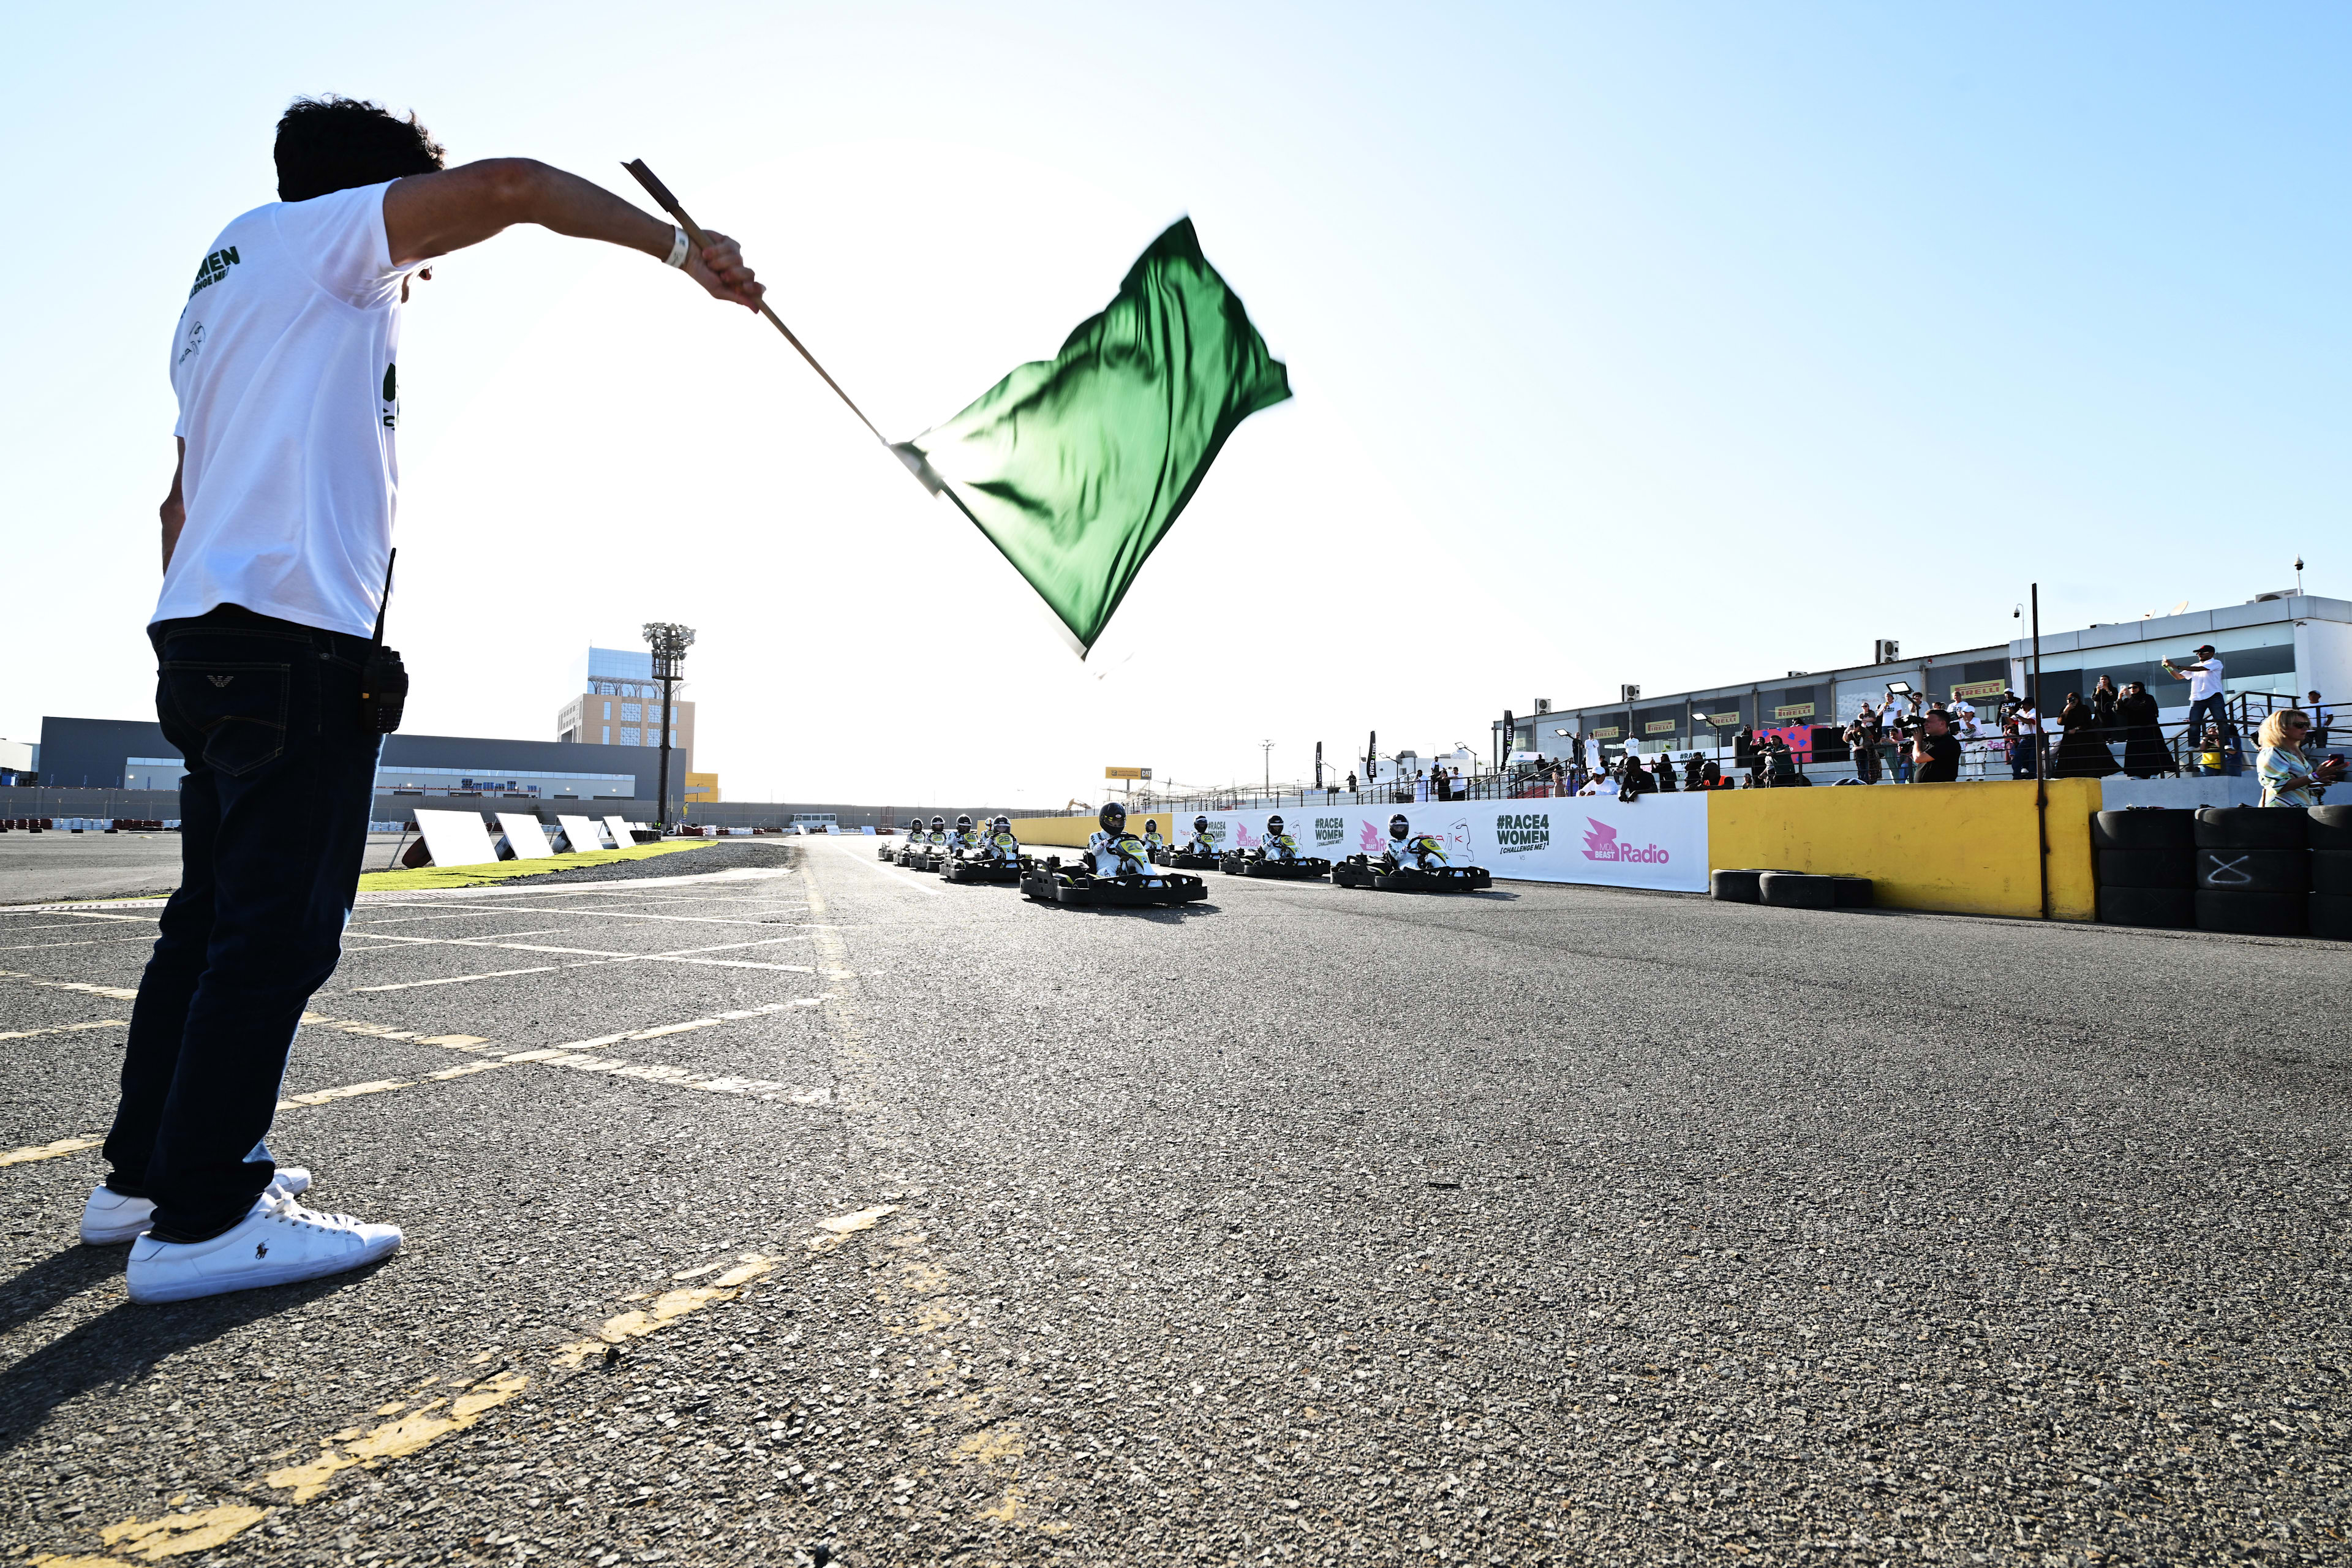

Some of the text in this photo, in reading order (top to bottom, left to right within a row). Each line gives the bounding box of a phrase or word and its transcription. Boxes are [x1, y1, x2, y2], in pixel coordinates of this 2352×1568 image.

[1778, 705, 1811, 717] PIRELLI
[1648, 722, 1673, 731] PIRELLI
[1594, 728, 1616, 737] PIRELLI
[1208, 821, 1226, 830] #RACE4
[1314, 817, 1344, 829] #RACE4
[1496, 814, 1549, 829] #RACE4
[1314, 829, 1344, 841] WOMEN
[1496, 830, 1549, 846] WOMEN
[1126, 842, 1143, 851] 20
[1599, 843, 1615, 851] MDL
[1594, 850, 1616, 859] BEAST
[1620, 842, 1670, 864] Radio
